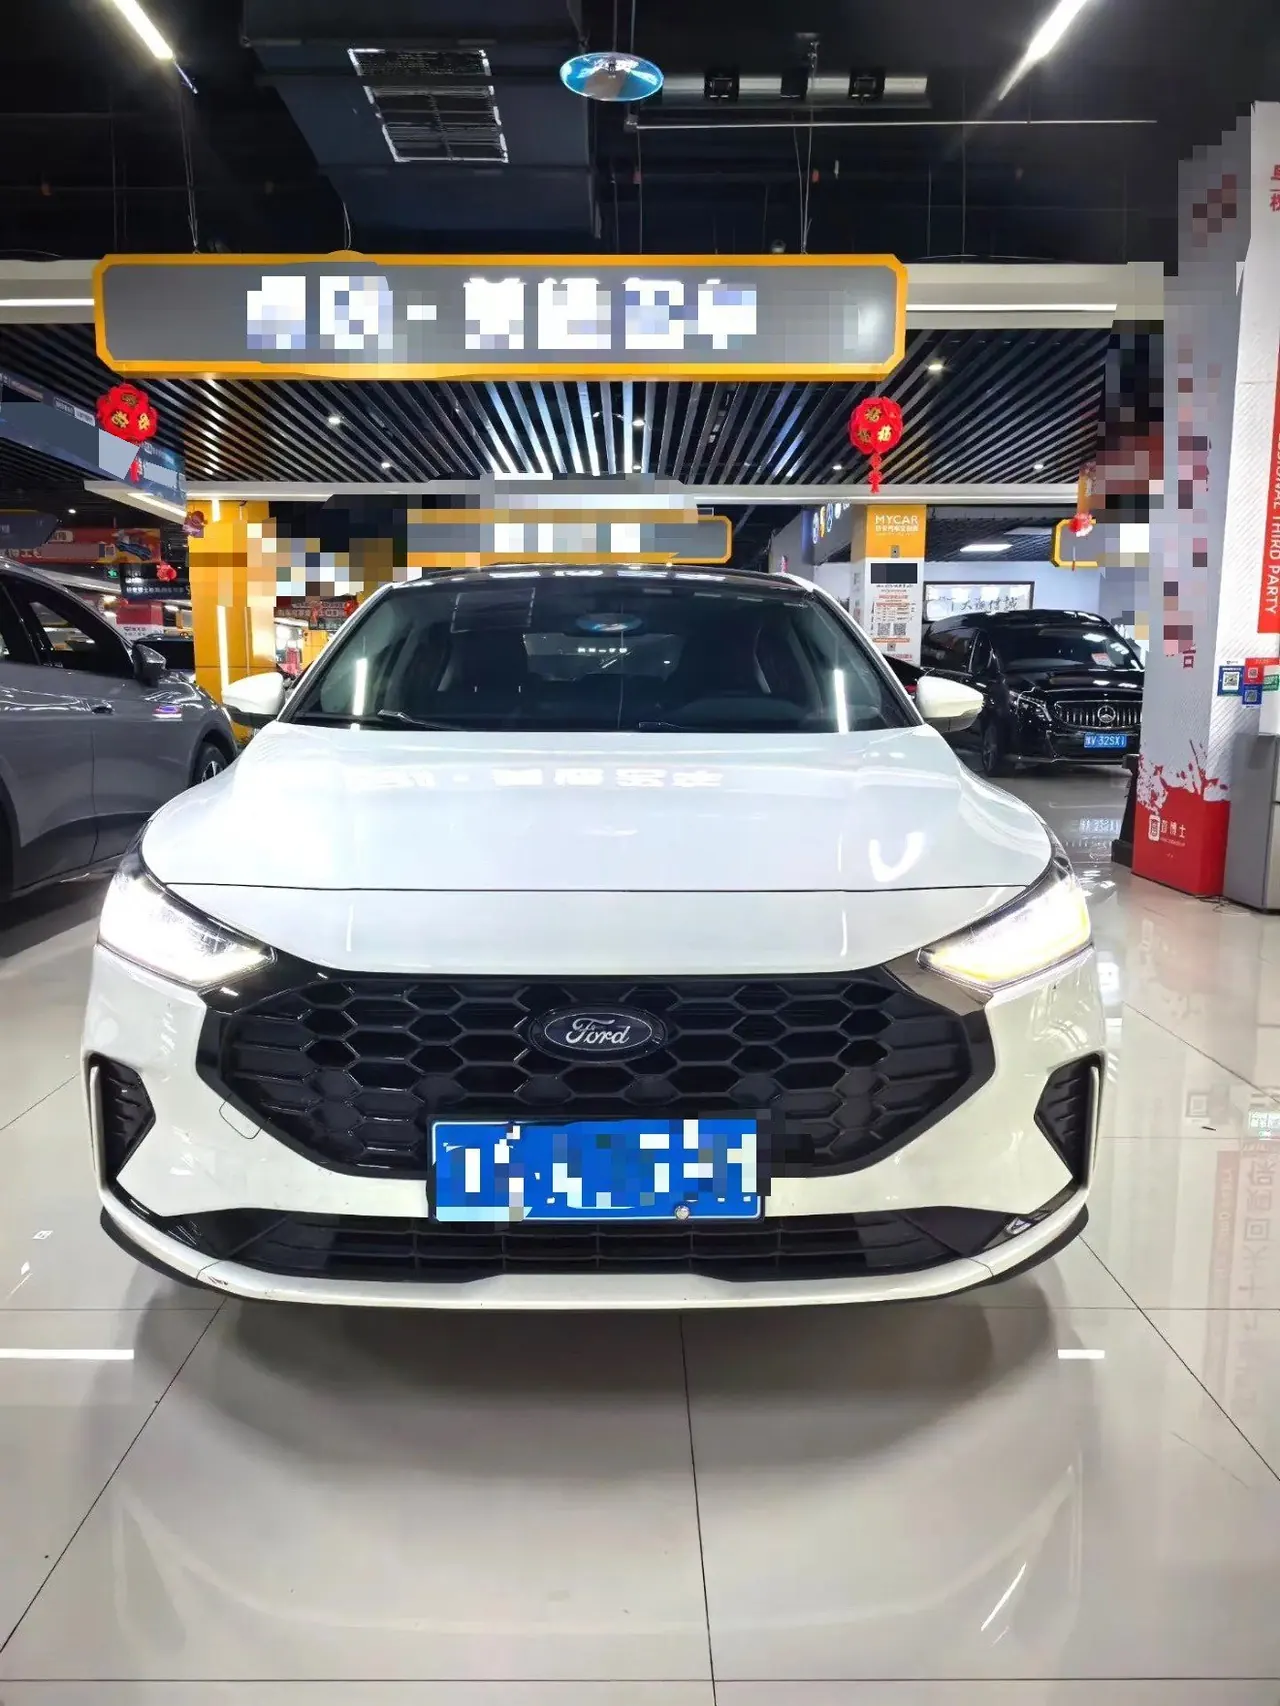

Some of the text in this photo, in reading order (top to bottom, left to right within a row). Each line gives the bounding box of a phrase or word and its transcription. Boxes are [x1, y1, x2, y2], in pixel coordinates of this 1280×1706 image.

[875, 514, 919, 525] MYCAR
[1264, 565, 1280, 615] PARTY
[565, 1017, 631, 1044] Ford
